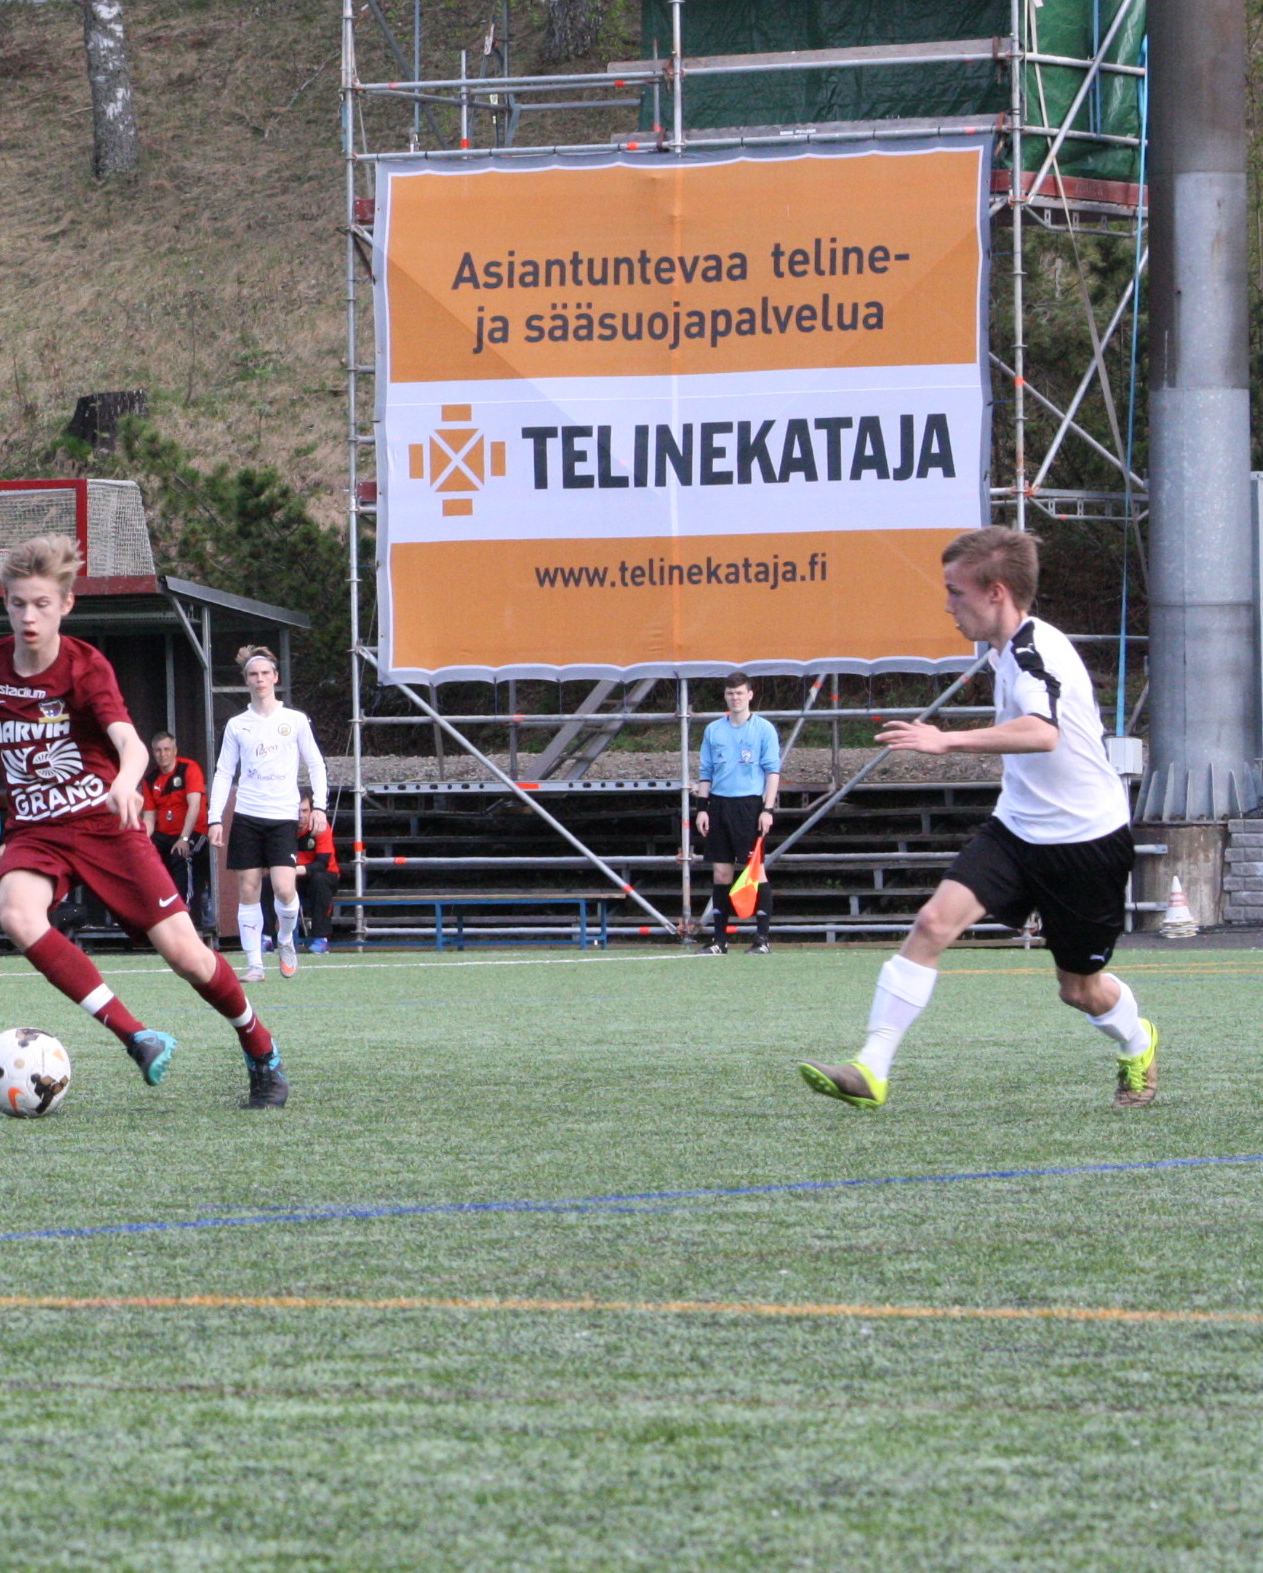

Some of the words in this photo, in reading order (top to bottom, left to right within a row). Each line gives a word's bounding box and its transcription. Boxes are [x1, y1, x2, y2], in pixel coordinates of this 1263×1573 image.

[451, 248, 749, 291] Asiantuntevaa
[771, 237, 911, 279] teline-
[472, 305, 510, 355] ja
[524, 293, 885, 350] sääsuojapalvelua
[521, 413, 956, 490] TELINEKATAJA
[535, 552, 827, 590] www.telinekataja.fi
[15, 777, 104, 815] GRANO
